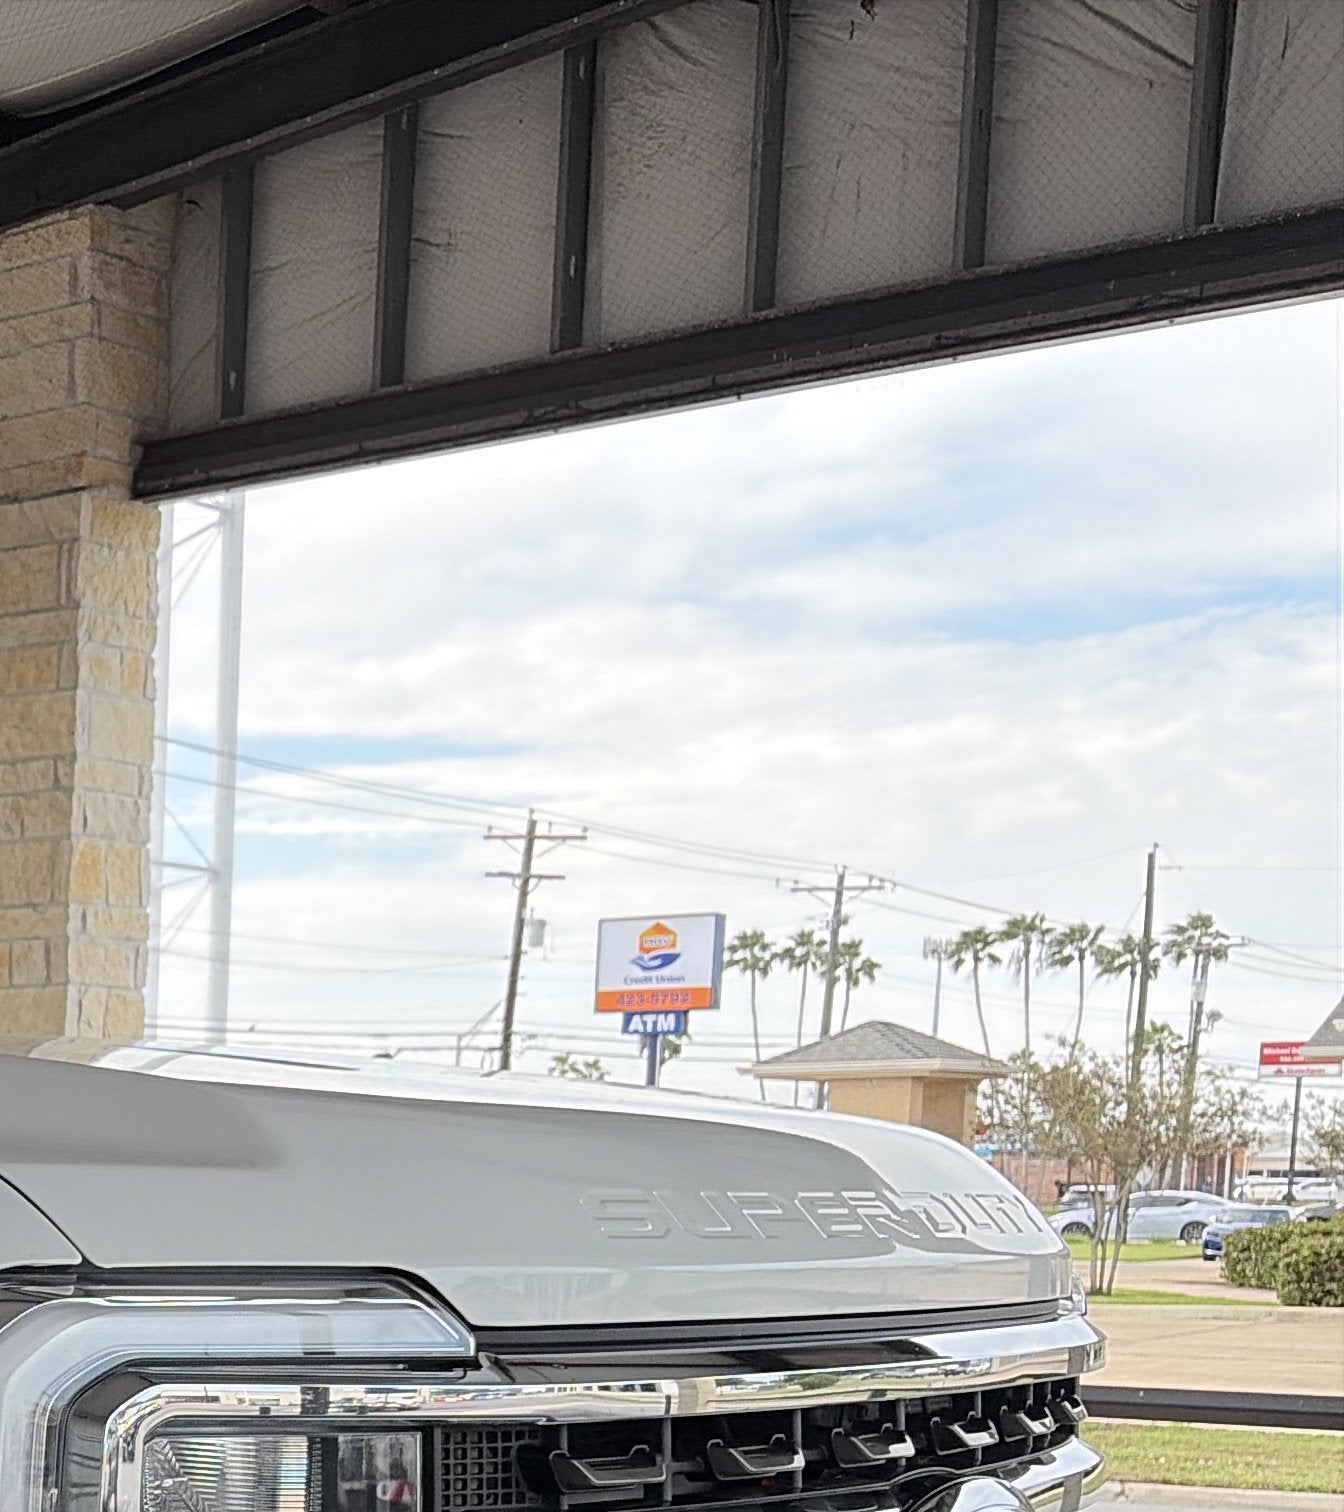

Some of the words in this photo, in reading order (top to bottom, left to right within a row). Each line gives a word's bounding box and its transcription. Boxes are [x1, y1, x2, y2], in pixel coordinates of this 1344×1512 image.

[623, 974, 654, 986] Credit
[656, 974, 686, 985] Union
[628, 1013, 676, 1033] ATM
